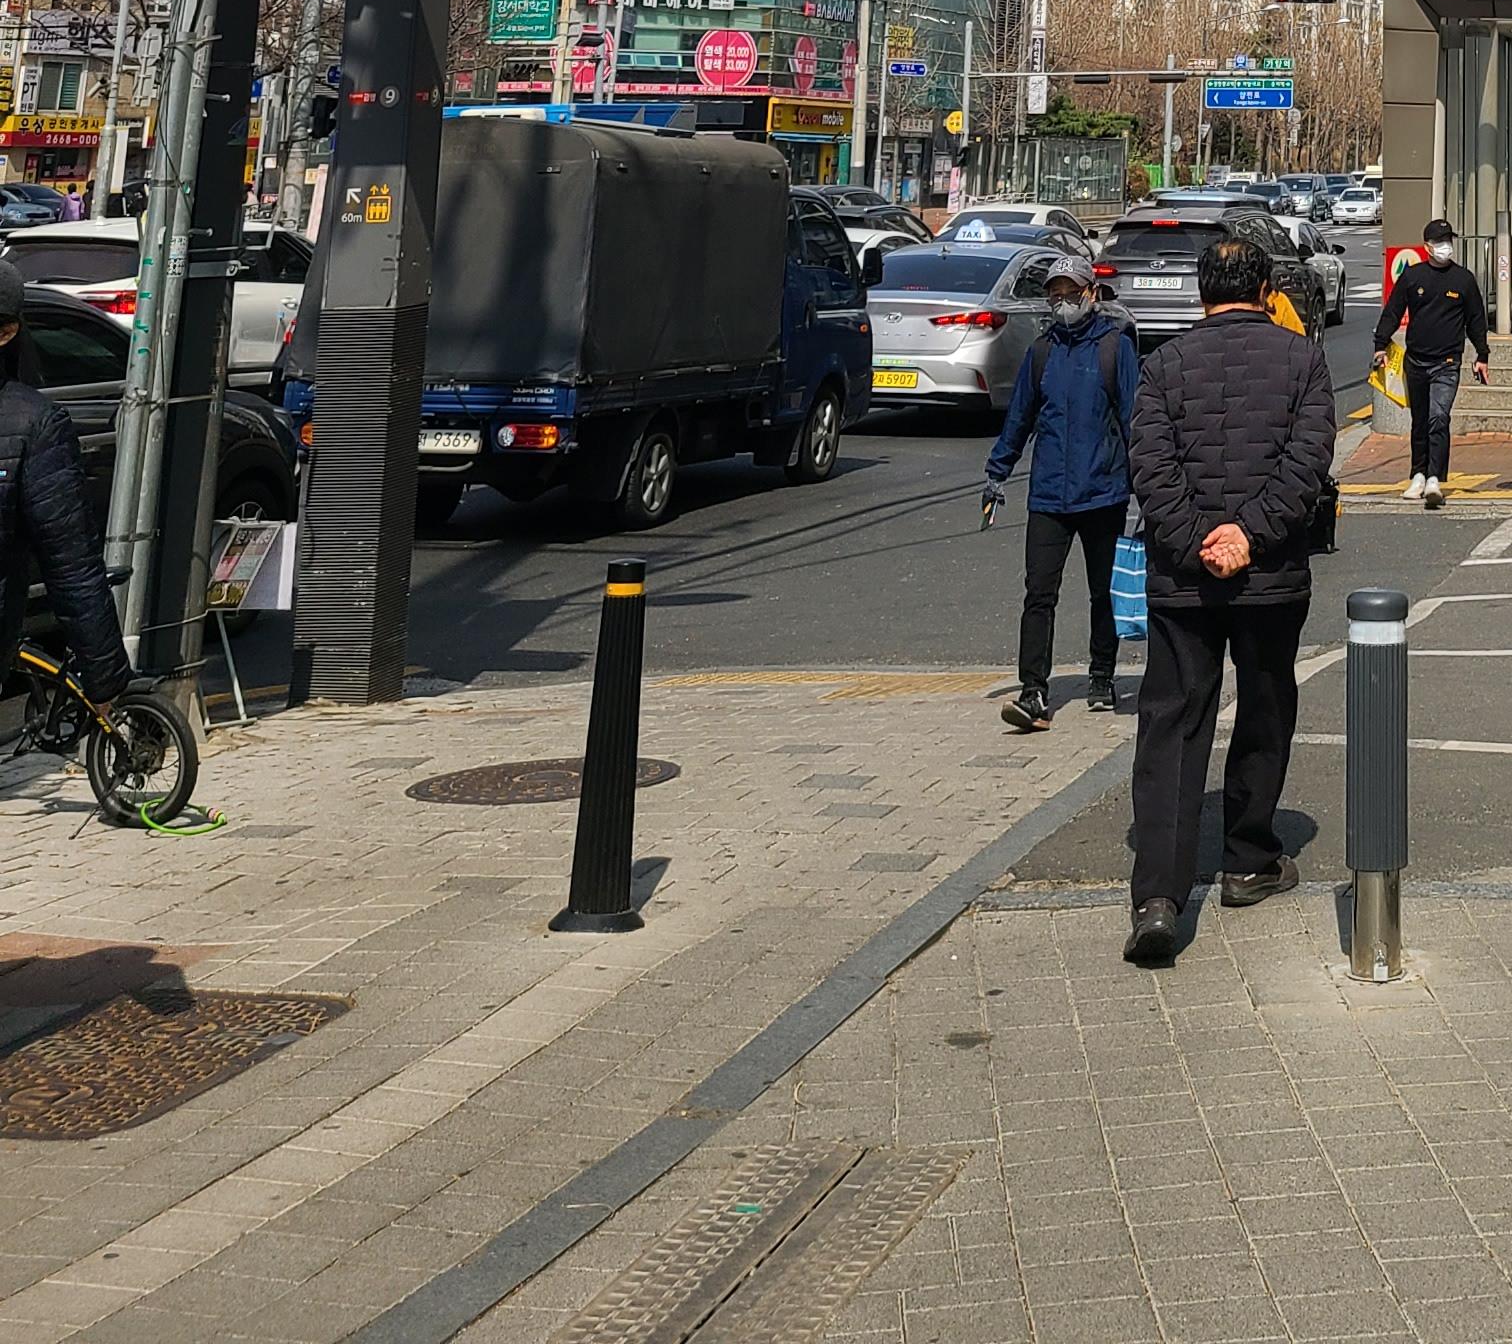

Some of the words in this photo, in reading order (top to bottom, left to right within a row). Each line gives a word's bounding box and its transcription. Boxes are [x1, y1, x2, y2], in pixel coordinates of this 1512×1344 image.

[496, 0, 551, 13] 강서대학교
[22, 82, 37, 101] PT
[18, 117, 45, 136] 우성
[341, 212, 363, 223] 60m
[961, 231, 982, 239] TAXI
[886, 374, 914, 385] 5907
[434, 432, 472, 448] 9369
